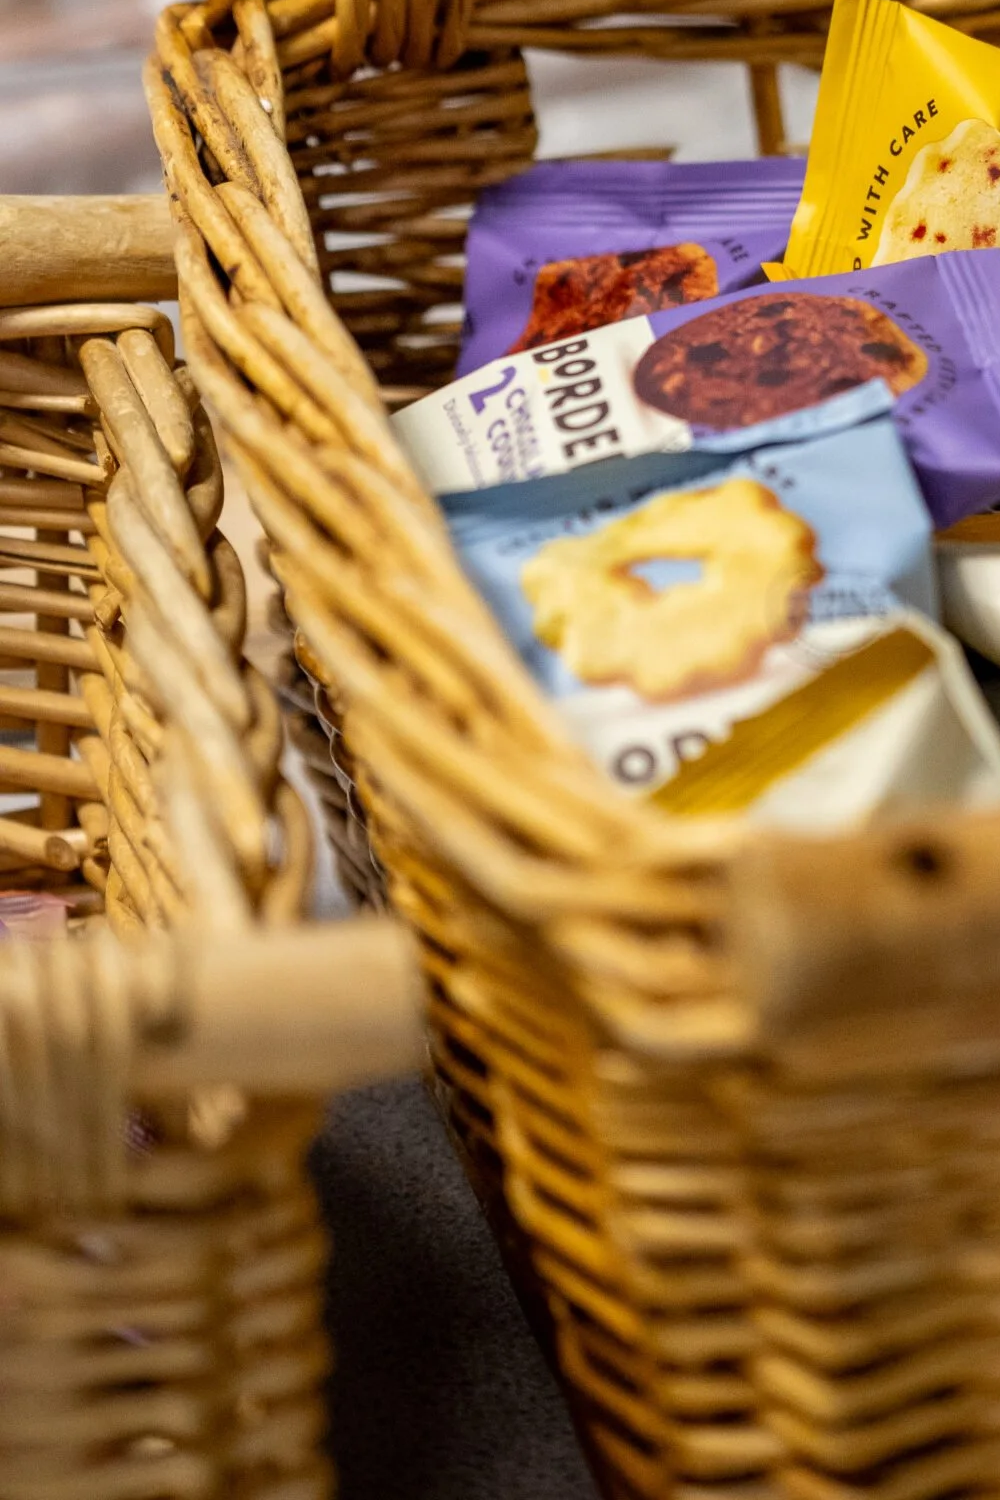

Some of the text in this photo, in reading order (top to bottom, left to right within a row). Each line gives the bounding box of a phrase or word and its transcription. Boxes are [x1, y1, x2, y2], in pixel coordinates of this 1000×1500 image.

[856, 98, 939, 241] WITH CARE
[468, 364, 518, 416] 2
[531, 338, 624, 460] BORDE
